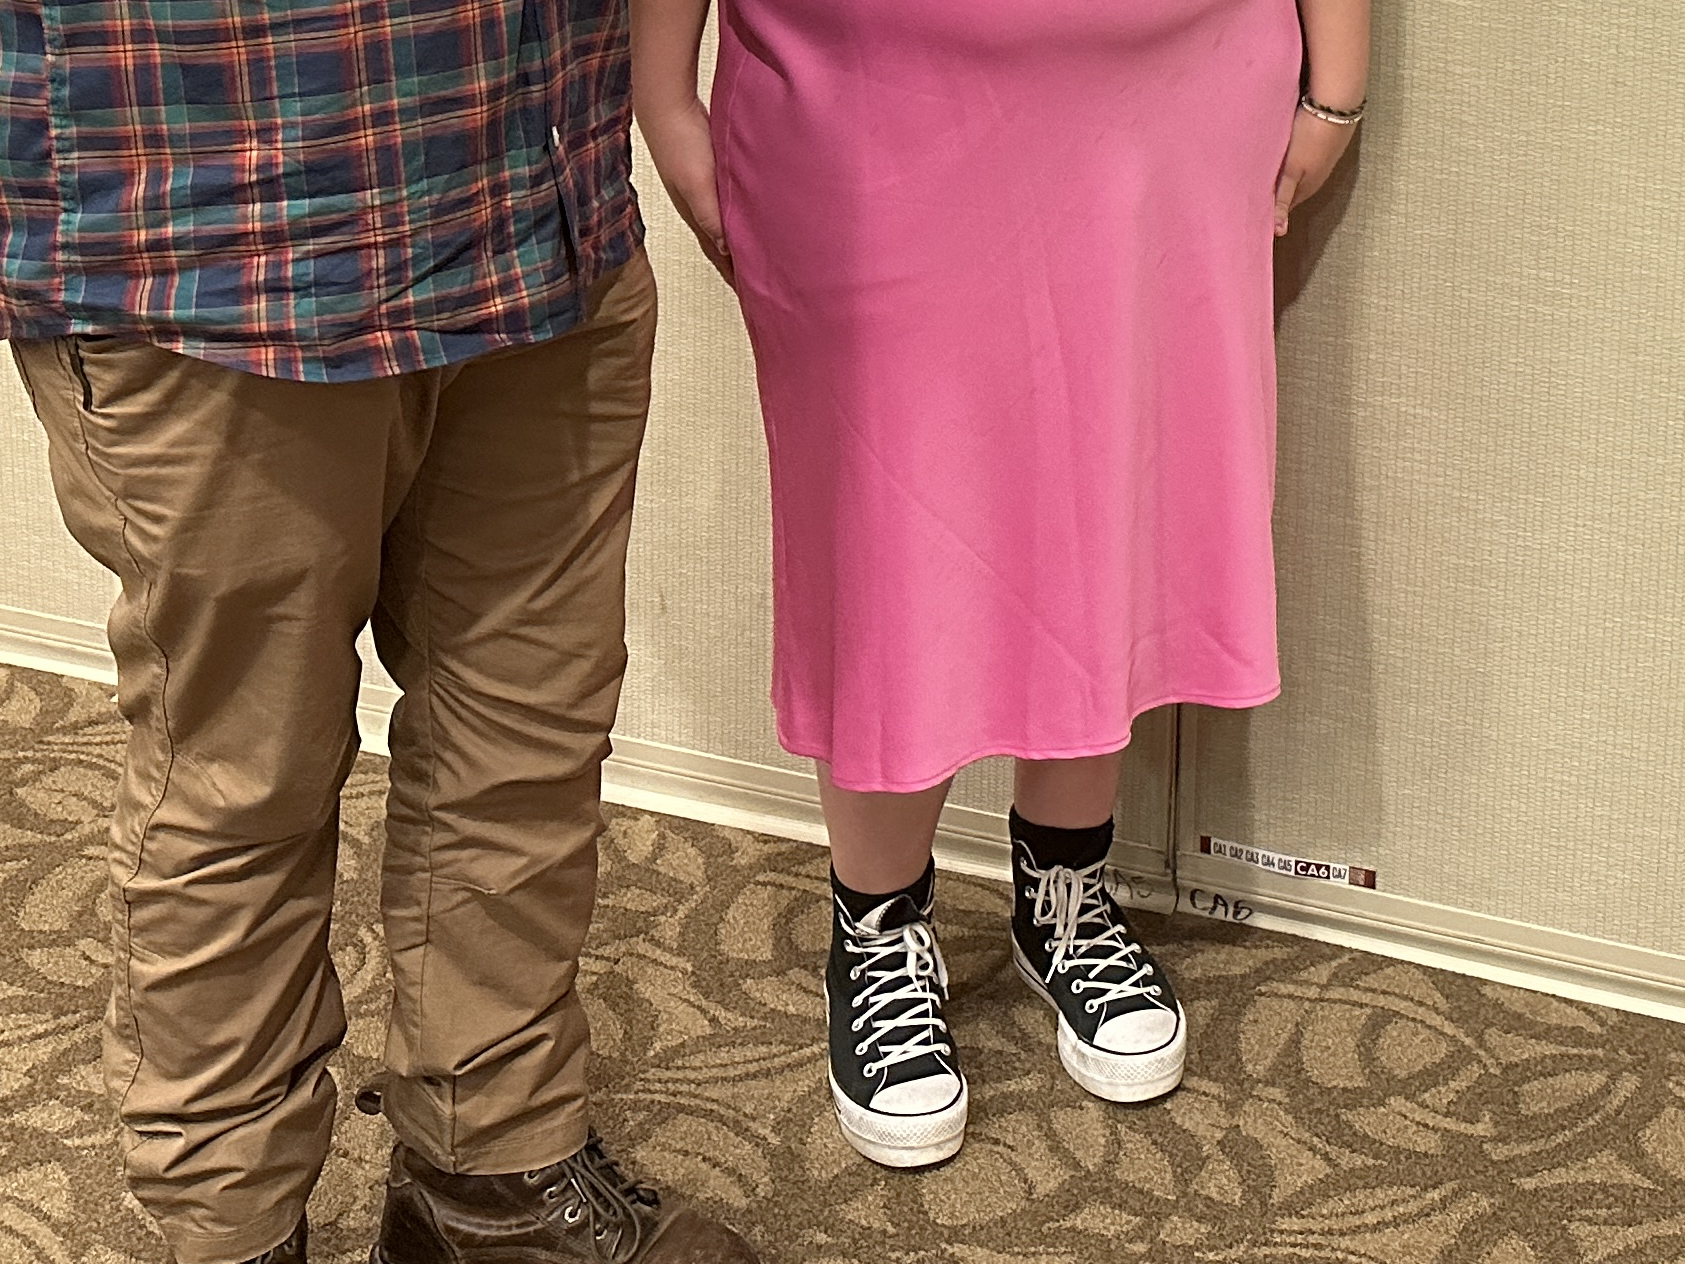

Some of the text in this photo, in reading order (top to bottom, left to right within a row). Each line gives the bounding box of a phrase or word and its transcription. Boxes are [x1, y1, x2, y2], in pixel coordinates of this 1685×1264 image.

[1213, 842, 1348, 880] CA1 CA2 CA3 CA4 CA5 CA6 CA7
[1190, 888, 1255, 921] CA6
